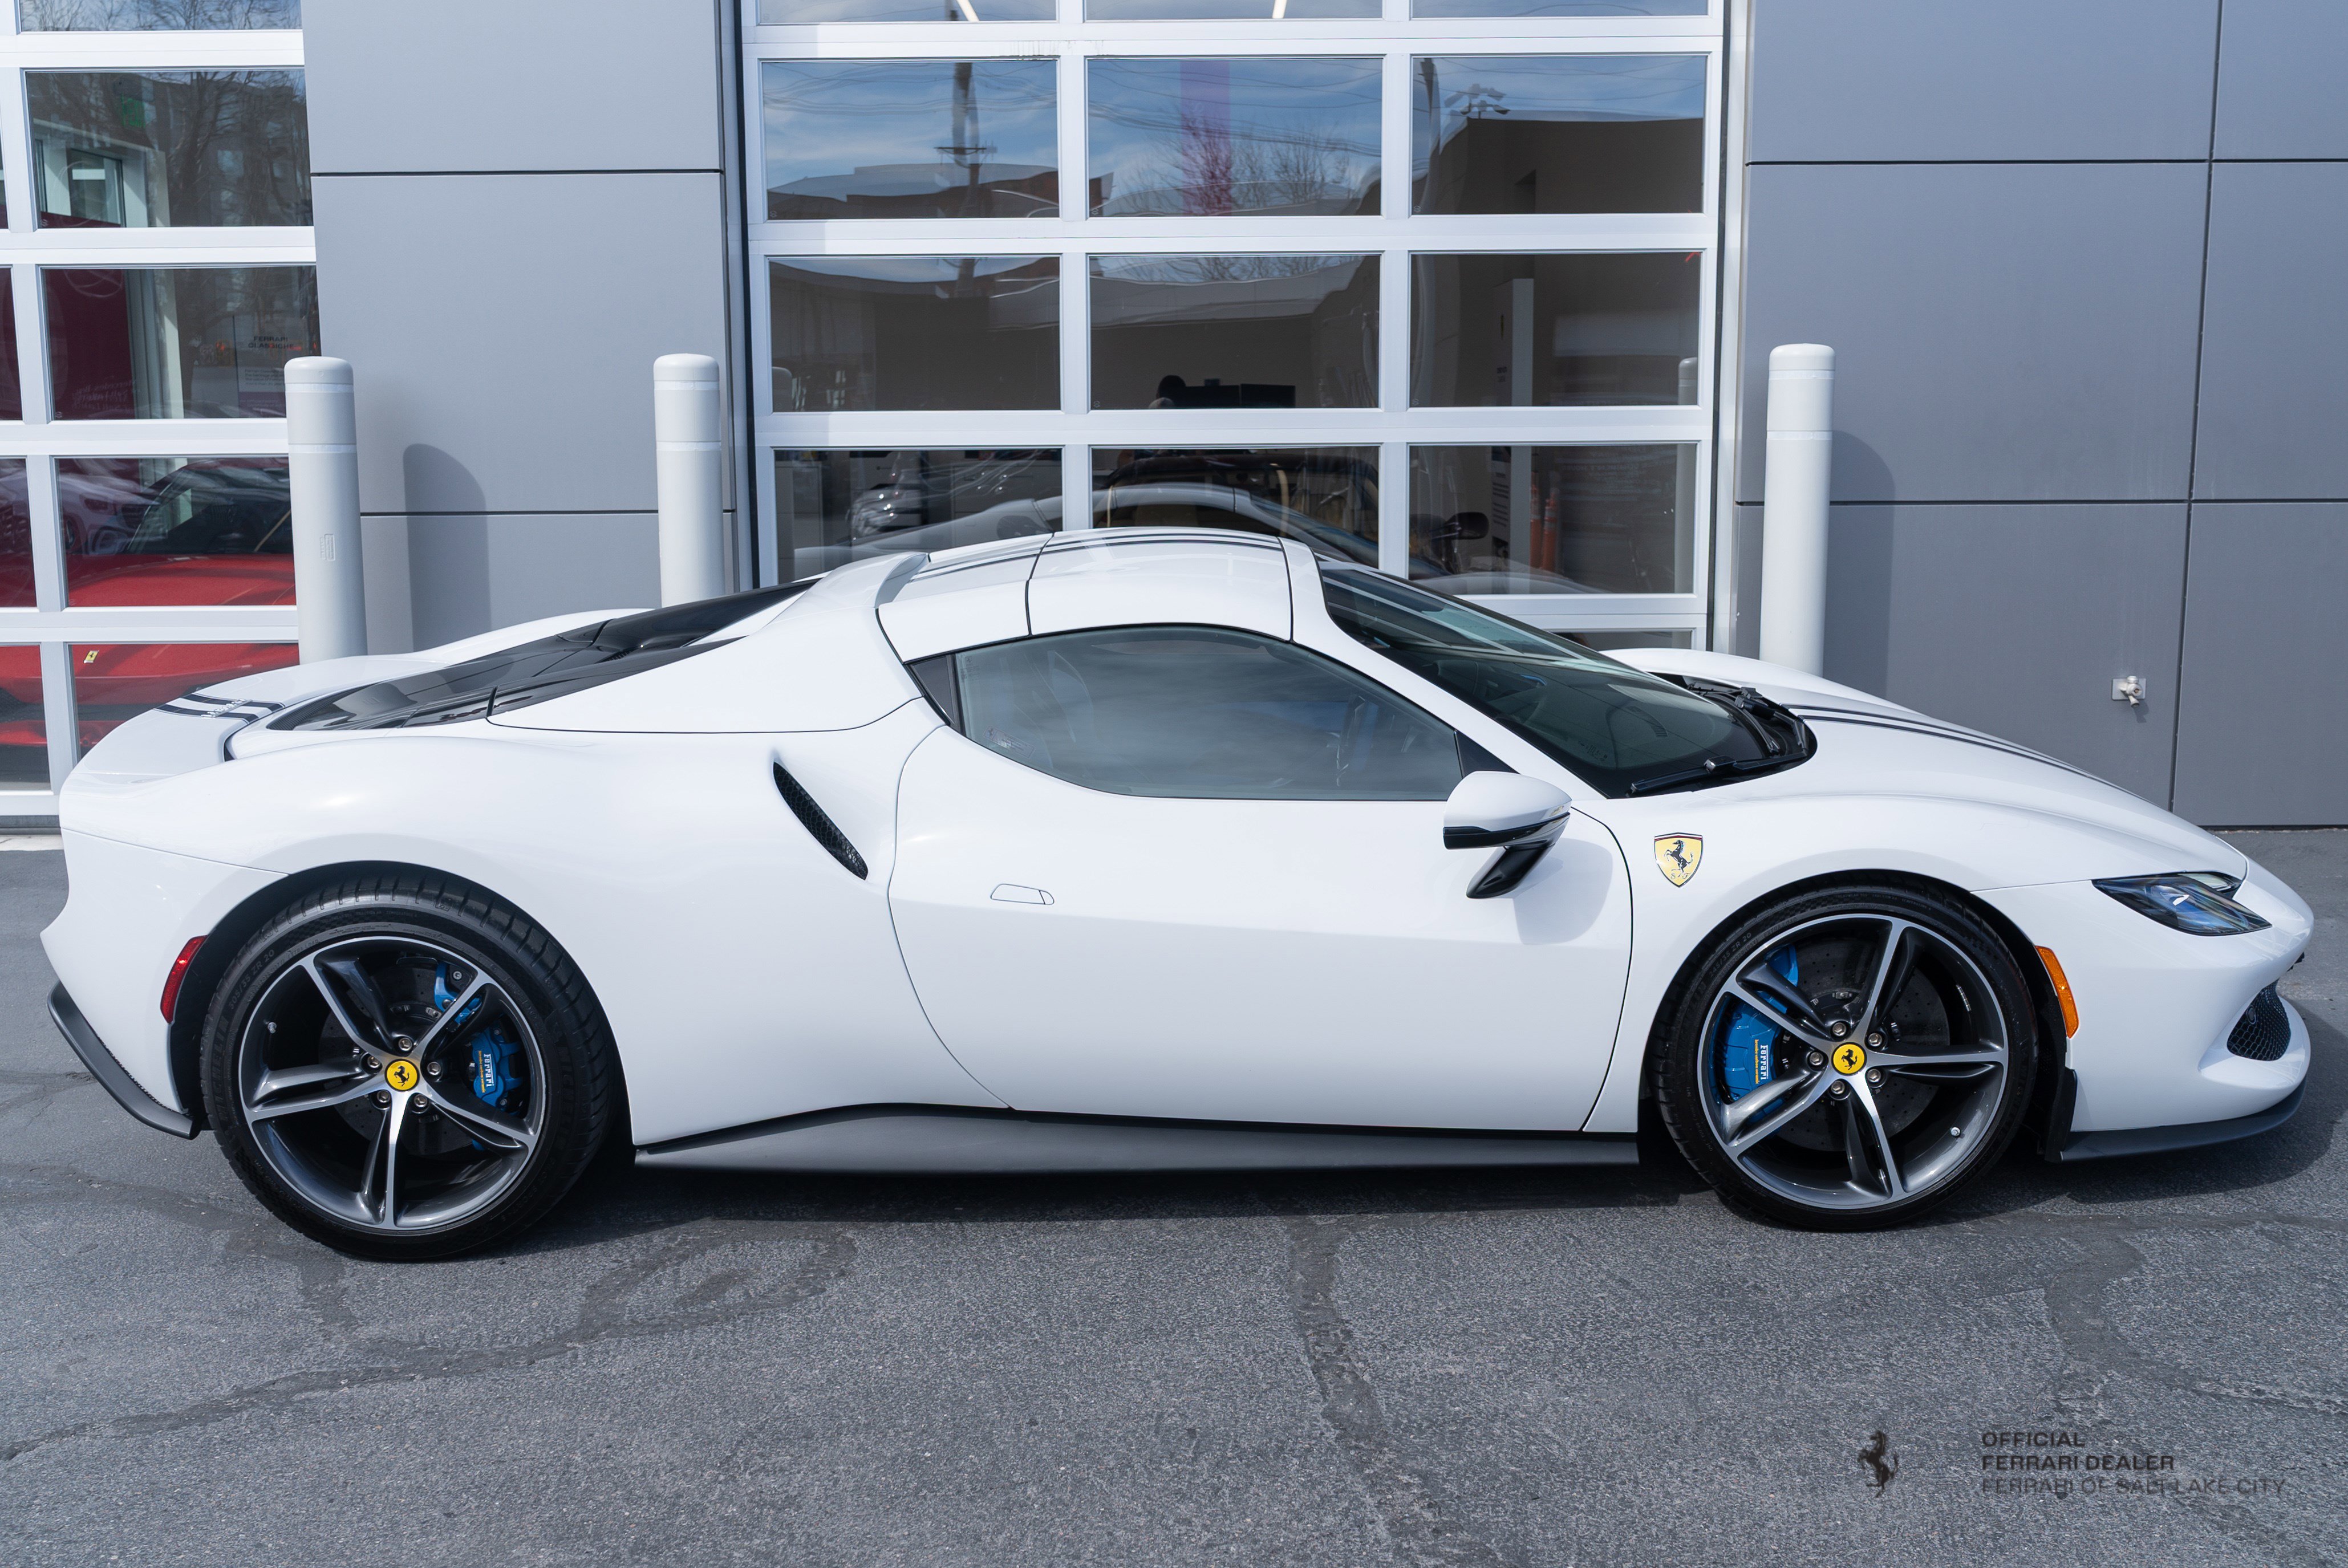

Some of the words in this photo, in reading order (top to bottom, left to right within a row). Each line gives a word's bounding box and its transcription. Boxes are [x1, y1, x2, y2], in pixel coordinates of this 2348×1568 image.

[1731, 941, 1741, 952] ZR
[1742, 932, 1751, 942] 20
[228, 973, 251, 1010] 305/35
[251, 960, 263, 976] ZR
[263, 949, 275, 962] 20
[484, 1053, 495, 1087] Ferrari
[1760, 1045, 1769, 1080] Ferrari
